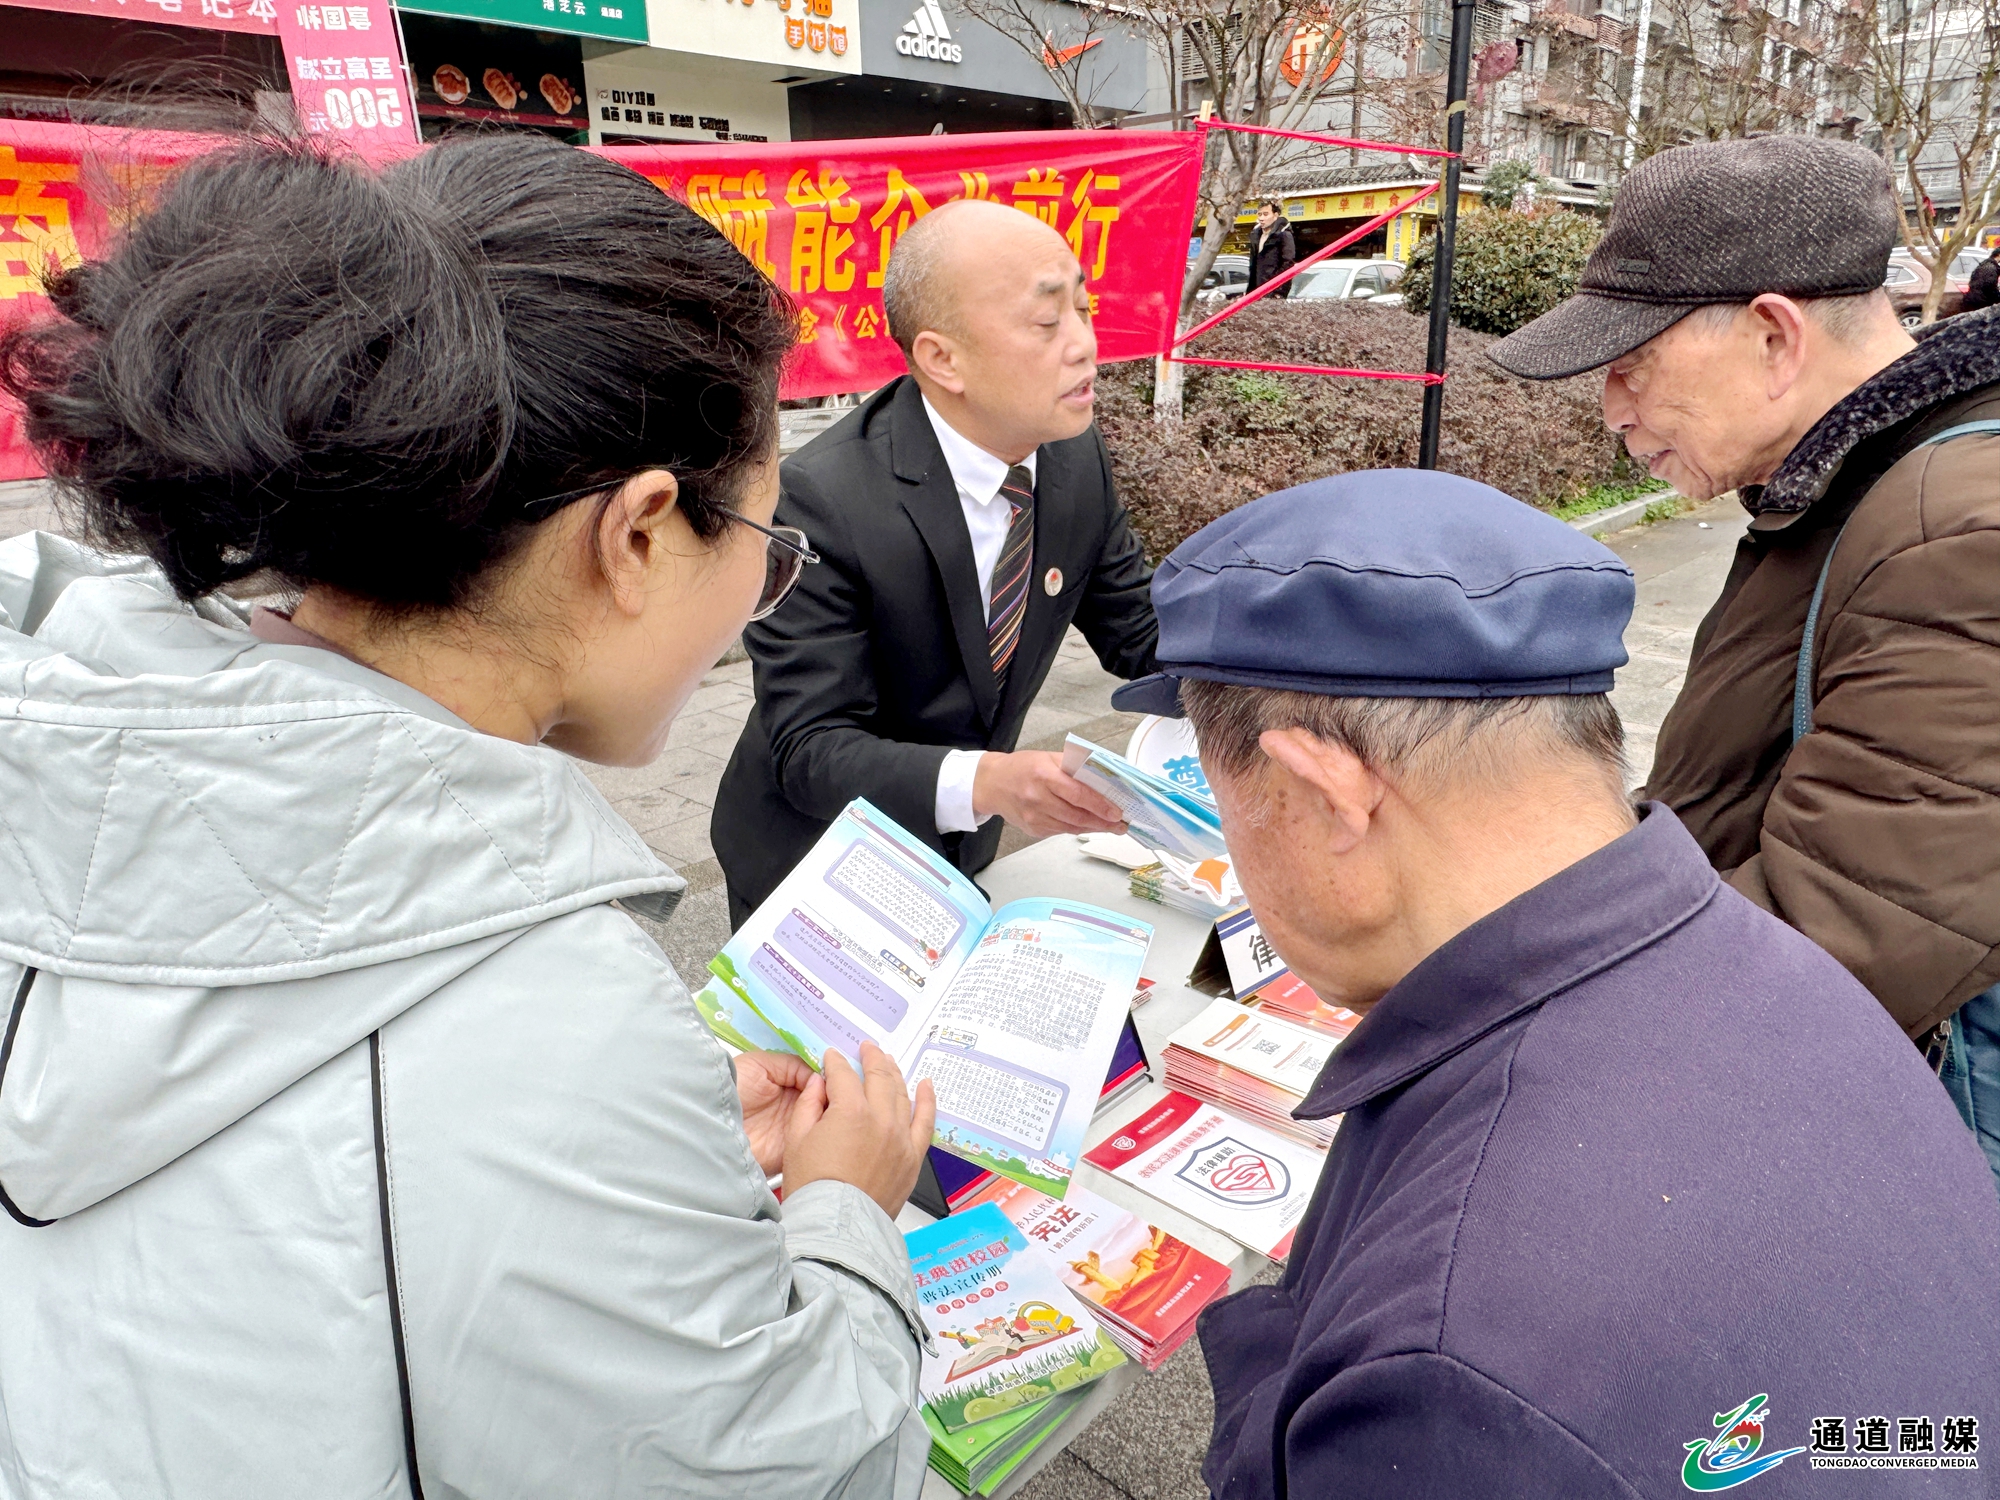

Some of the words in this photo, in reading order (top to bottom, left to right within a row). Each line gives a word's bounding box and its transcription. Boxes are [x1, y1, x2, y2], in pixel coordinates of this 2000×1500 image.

[787, 19, 848, 54] 手作馆
[895, 34, 962, 63] adidas
[796, 303, 891, 344] 念《公
[1248, 934, 1281, 974] 律
[1195, 1144, 1241, 1177] 法律援助
[1028, 1203, 1081, 1244] 宪法
[922, 1263, 1004, 1304] 普法宣传册
